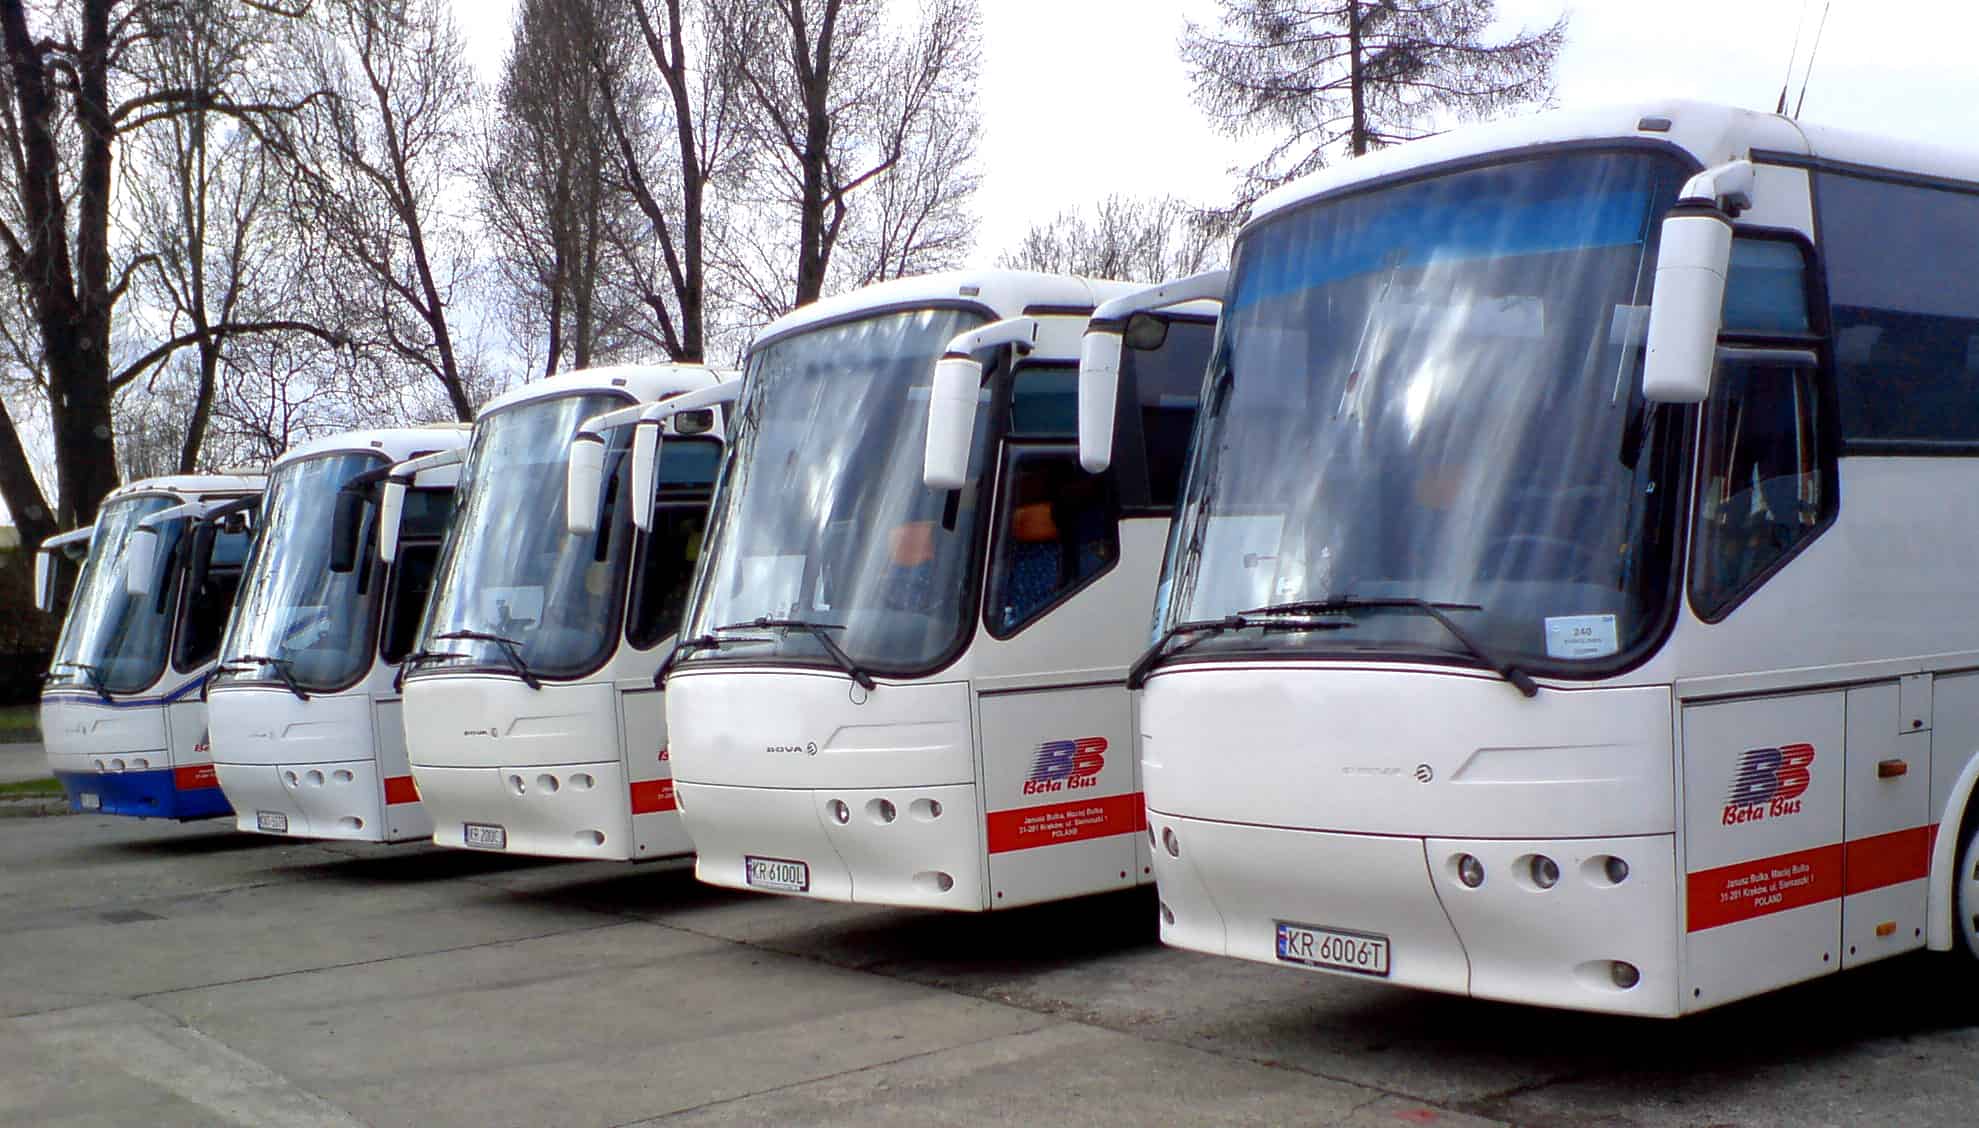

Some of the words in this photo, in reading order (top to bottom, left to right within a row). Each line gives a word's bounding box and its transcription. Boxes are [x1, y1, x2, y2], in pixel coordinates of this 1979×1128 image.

[1023, 779, 1062, 796] Beta
[1067, 775, 1097, 790] Bus
[1722, 802, 1764, 826] Beta
[1768, 798, 1802, 817] Bus
[1051, 827, 1079, 840] POLAND
[751, 861, 766, 880] KR
[769, 863, 803, 885] 6100L
[1727, 877, 1749, 889] Janusz
[1754, 893, 1783, 908] POLAND
[1288, 930, 1314, 957] KR
[1320, 936, 1383, 969] 6006T
